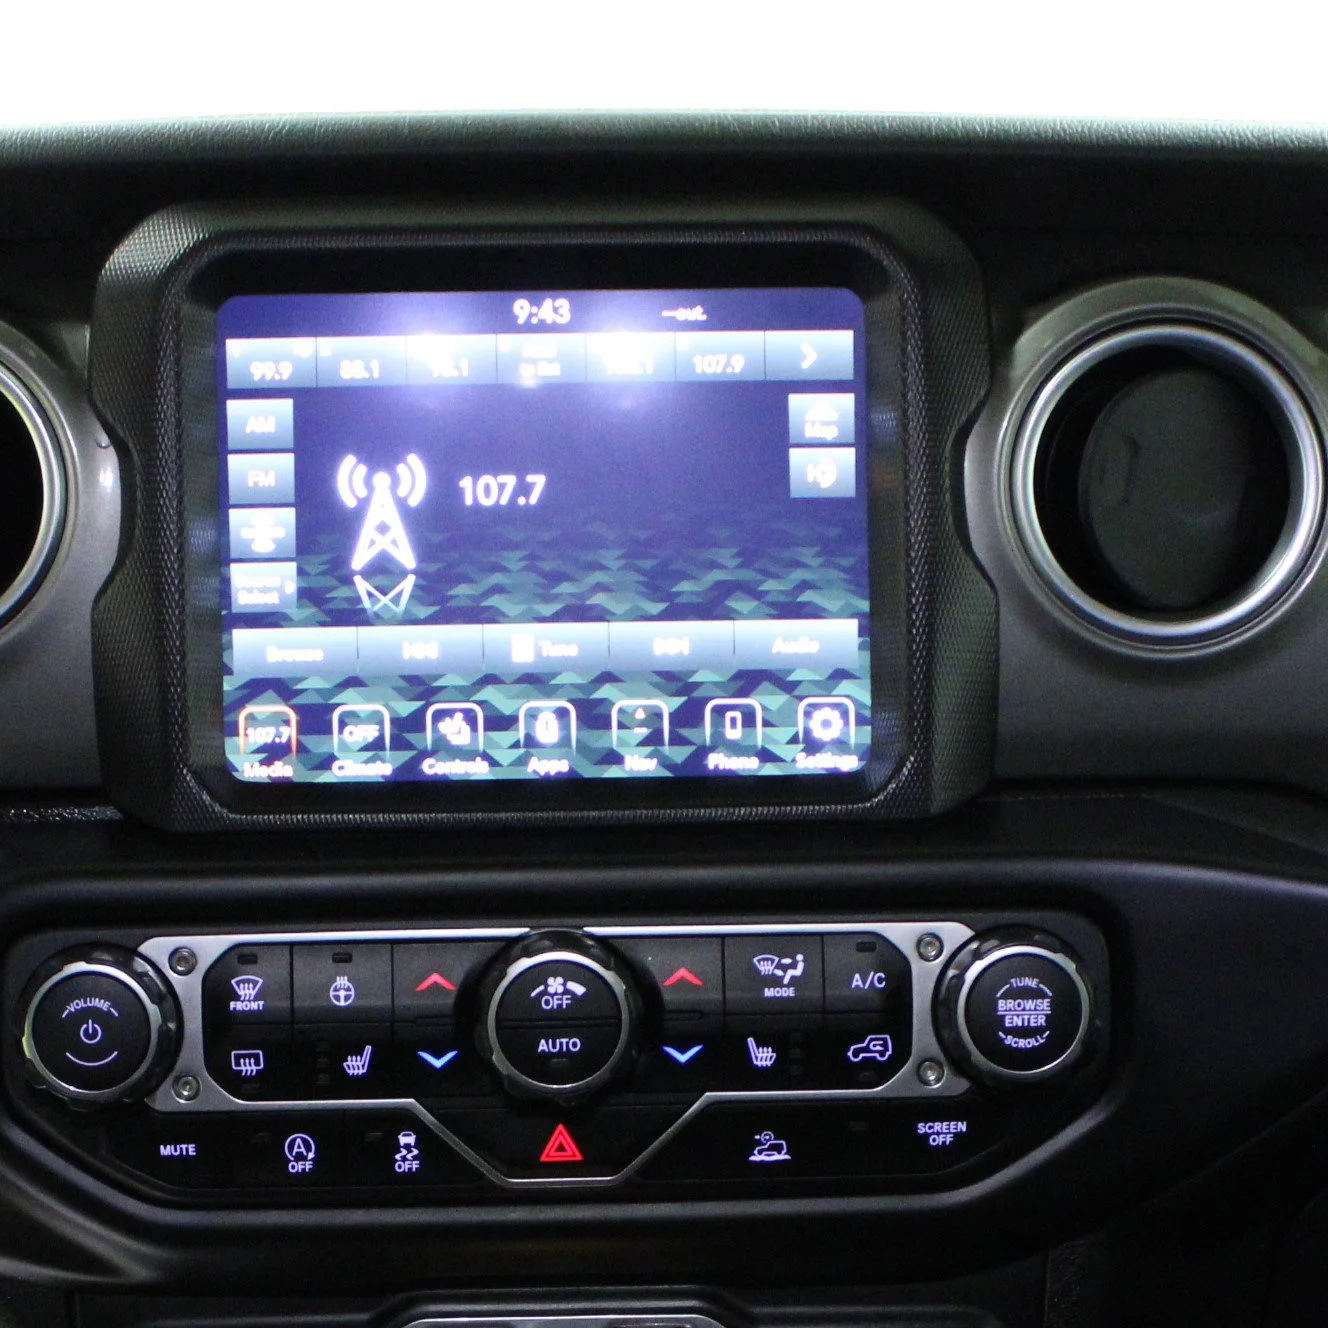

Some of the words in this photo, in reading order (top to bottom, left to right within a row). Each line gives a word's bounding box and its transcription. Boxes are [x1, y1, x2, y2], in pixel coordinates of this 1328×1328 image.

[513, 298, 571, 324] 9:43
[249, 360, 293, 381] 99.9
[692, 354, 745, 374] 107.9
[244, 415, 275, 434] AM
[247, 470, 276, 488] FM
[458, 474, 547, 507] 107.7
[539, 640, 579, 657] Tune
[245, 725, 292, 744] 107.7
[342, 724, 380, 742] OFF
[244, 761, 293, 778] Media
[332, 759, 393, 776] Climate
[422, 757, 489, 776] Controls
[527, 756, 569, 776] Apps
[624, 754, 659, 772] Nav
[707, 753, 760, 771] Phone
[795, 752, 859, 772] Settings
[851, 971, 886, 990] A/C
[1010, 977, 1040, 989] TUNE
[764, 986, 795, 998] MODE
[66, 997, 111, 1014] VOLUME
[230, 1001, 264, 1012] FRONT
[541, 995, 572, 1010] OFF
[998, 998, 1052, 1011] BROWSE
[1004, 1015, 1046, 1027] ENTER
[537, 1037, 581, 1053] AUTO
[1004, 1035, 1046, 1049] SCROLL
[917, 1121, 967, 1134] SCREEN
[929, 1135, 954, 1146] OFF
[159, 1144, 197, 1157] MUTE
[288, 1161, 314, 1173] OFF
[394, 1160, 420, 1173] OFF
